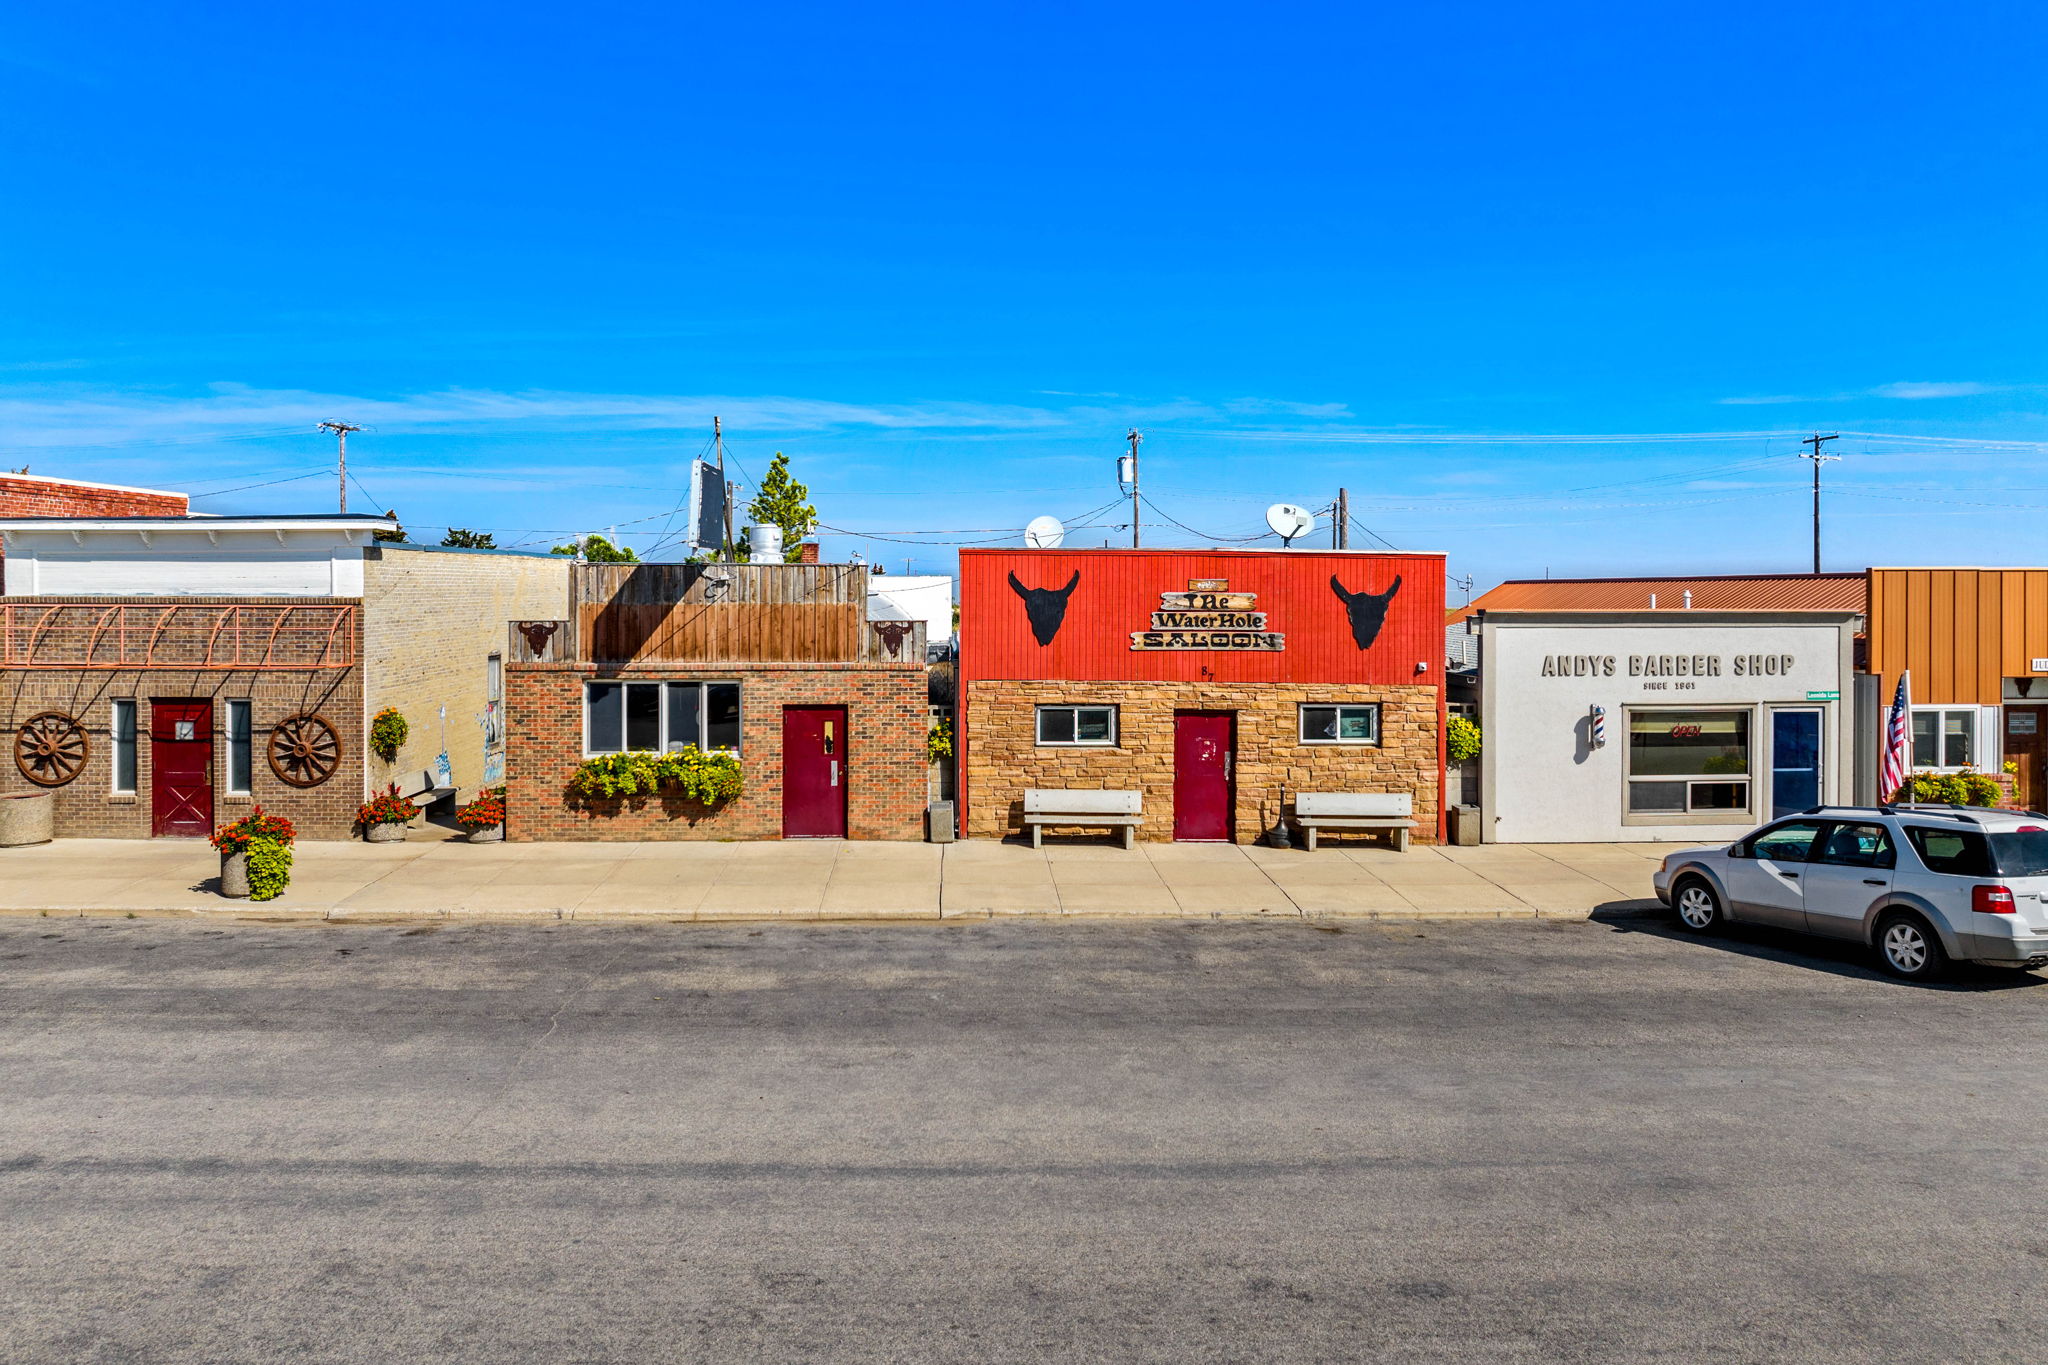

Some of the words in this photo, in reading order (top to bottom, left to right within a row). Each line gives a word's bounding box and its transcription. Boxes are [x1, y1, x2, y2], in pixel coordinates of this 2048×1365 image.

[1183, 593, 1229, 610] The
[1143, 633, 1276, 648] SALOON
[1541, 655, 1617, 677] ANDYS
[1628, 654, 1722, 677] BARBER
[1734, 654, 1795, 676] SHOP
[1643, 682, 1668, 690] SINCE
[1672, 725, 1702, 738] OPEN
